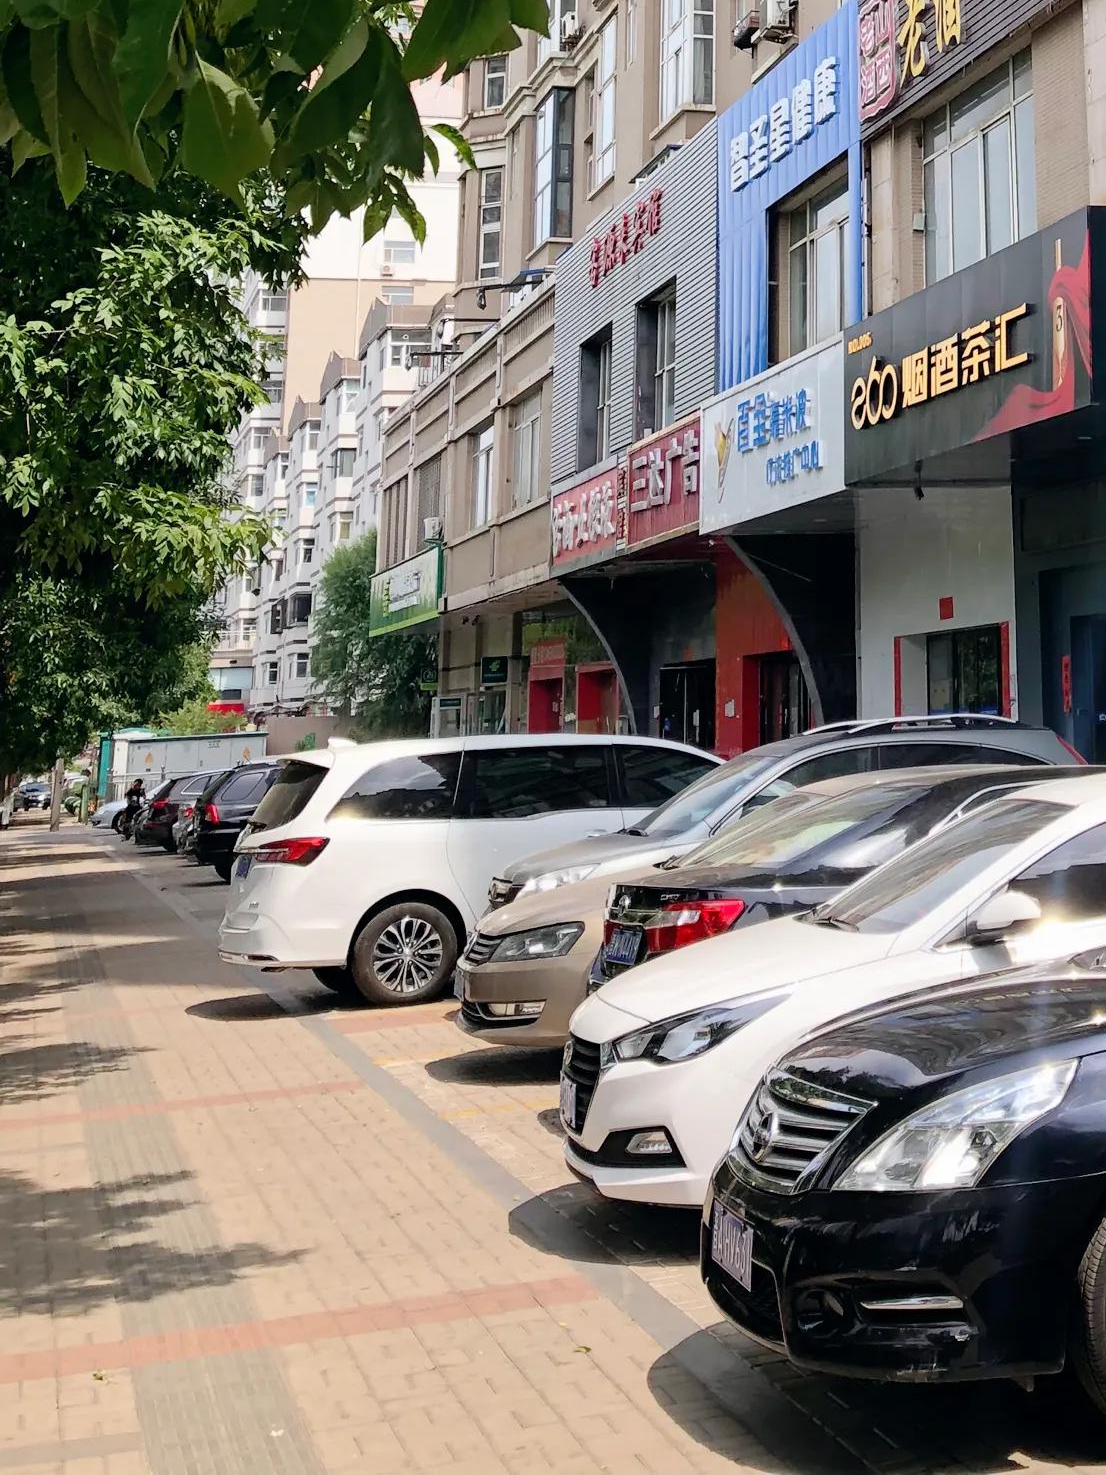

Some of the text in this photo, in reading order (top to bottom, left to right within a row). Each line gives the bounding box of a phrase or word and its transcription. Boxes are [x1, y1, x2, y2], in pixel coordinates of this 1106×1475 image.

[902, 302, 1029, 409] 烟酒茶汇
[630, 430, 700, 514] 三达广告
